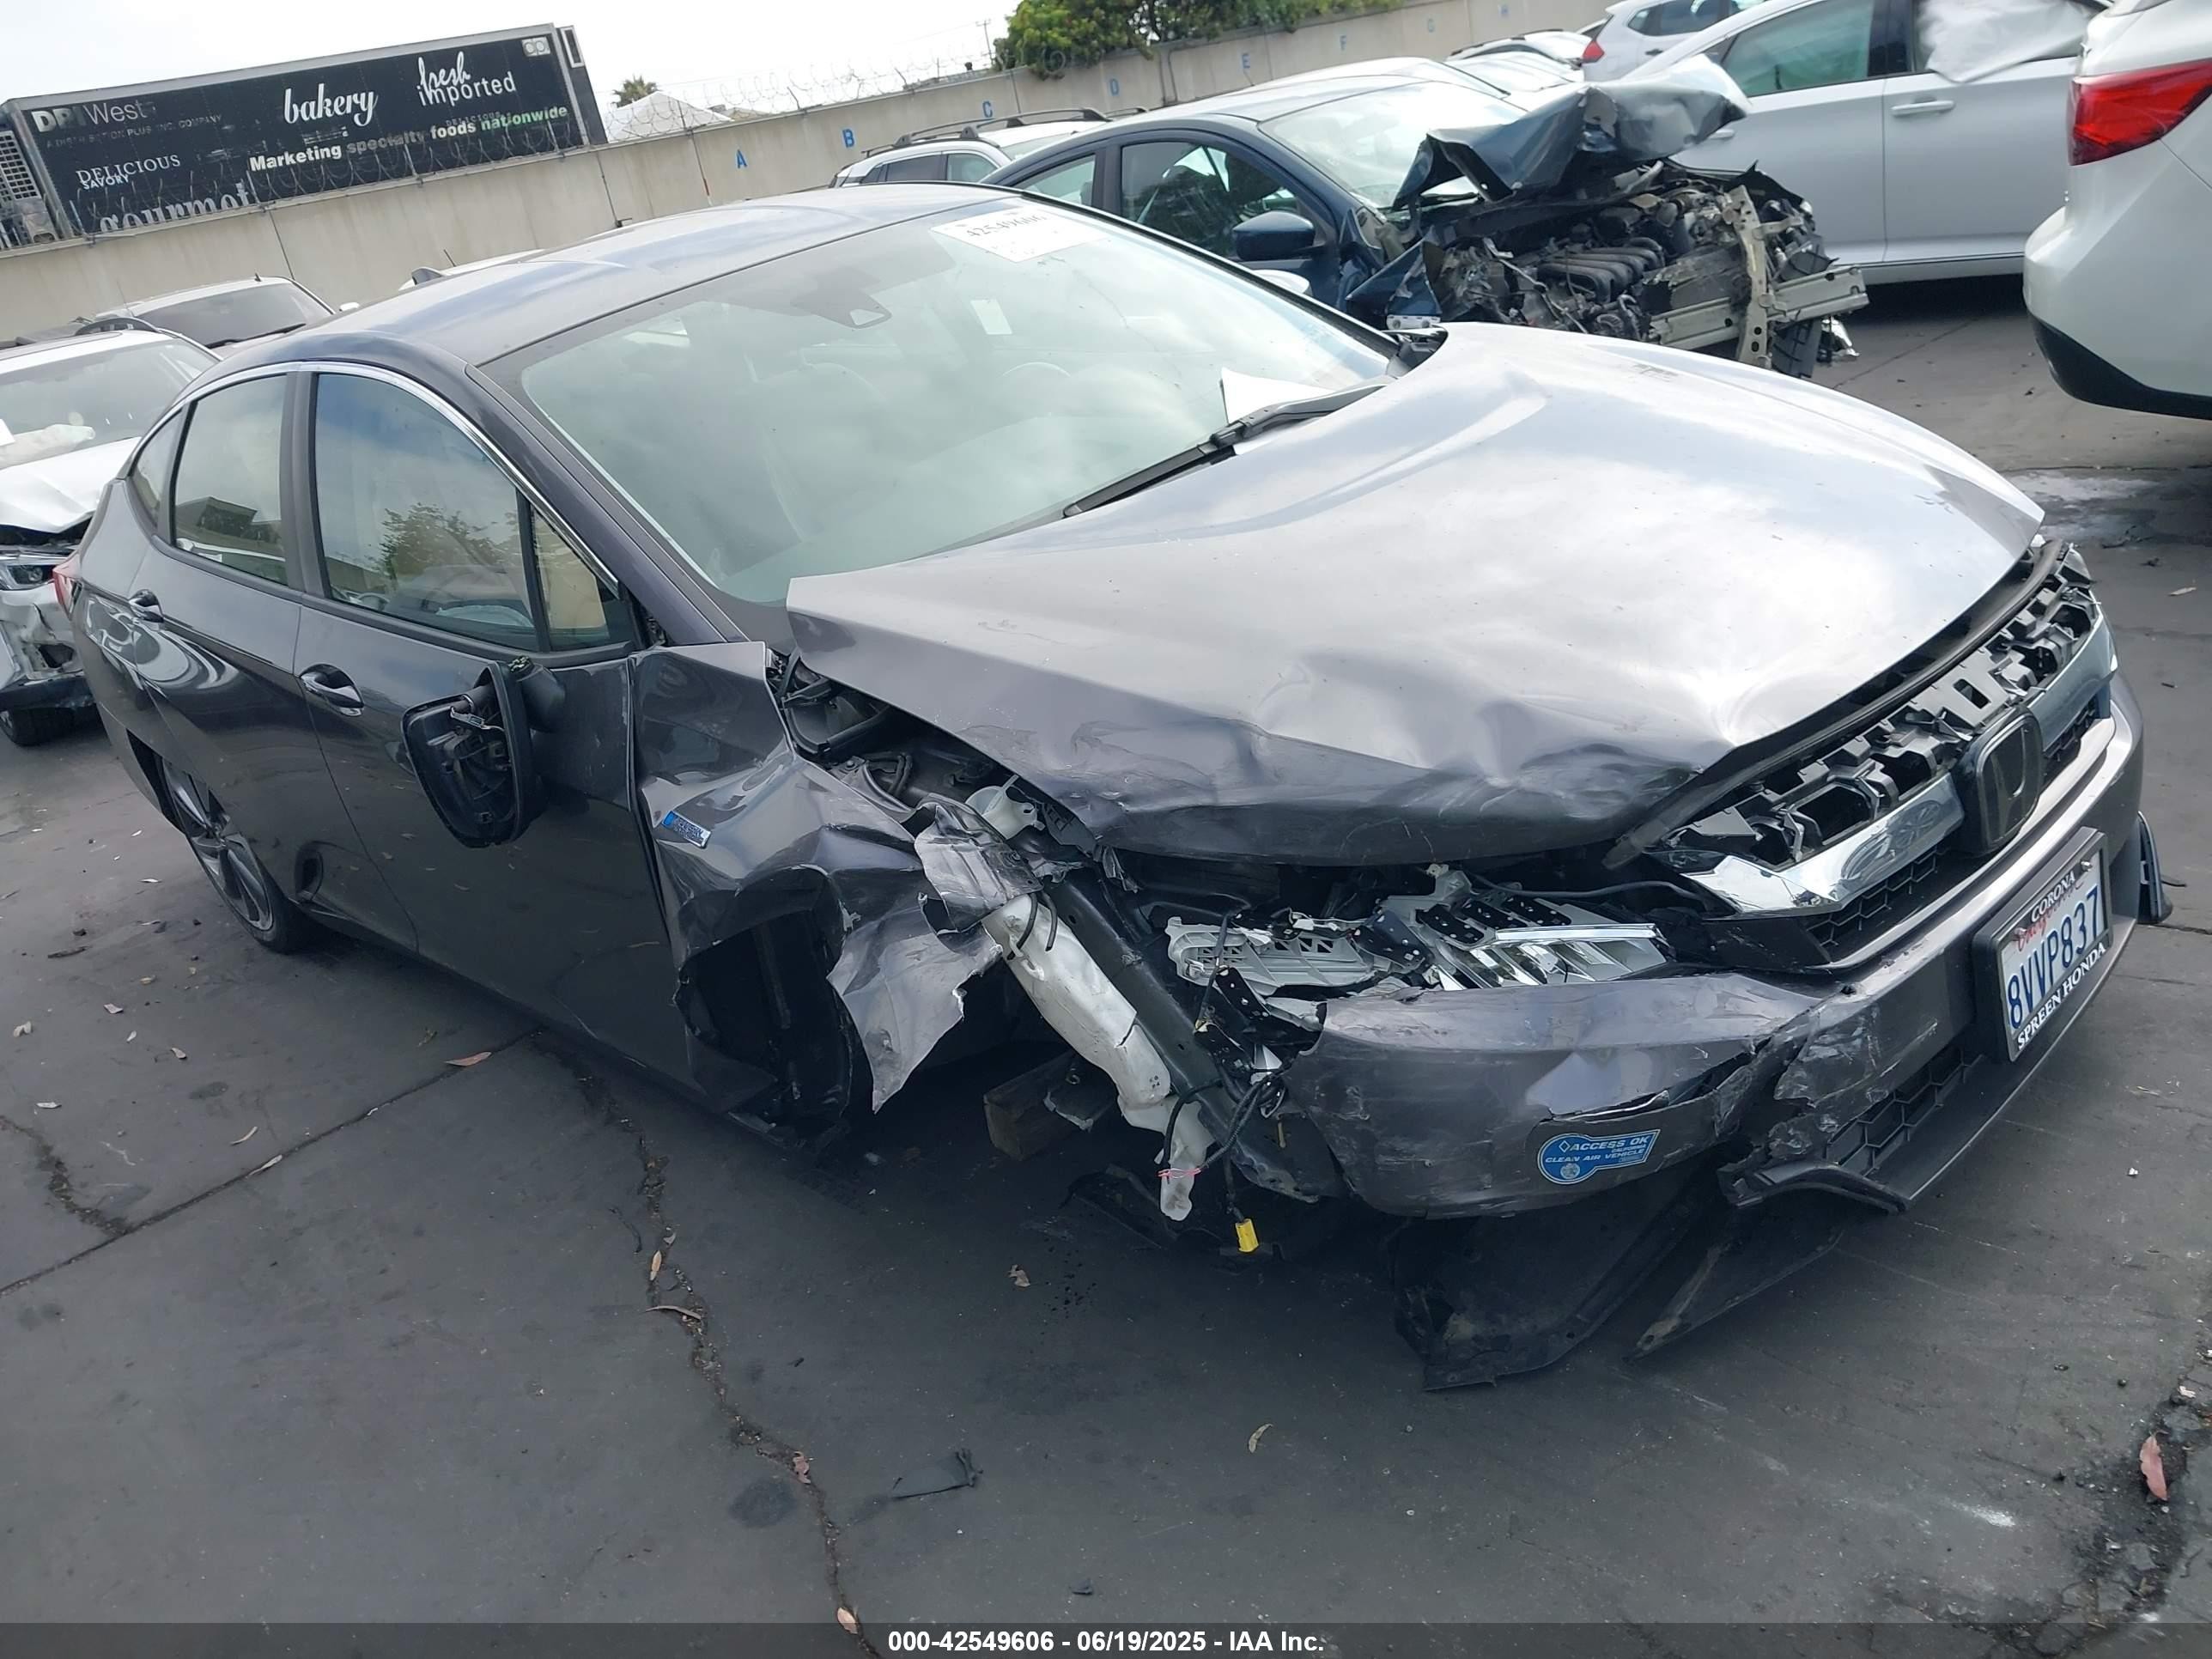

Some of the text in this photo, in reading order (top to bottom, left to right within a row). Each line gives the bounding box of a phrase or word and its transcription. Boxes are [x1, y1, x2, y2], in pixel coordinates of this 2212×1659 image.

[1242, 53, 1250, 69] E
[416, 71, 516, 106] imported
[418, 51, 471, 104] fresh
[1109, 78, 1120, 96] D
[83, 100, 148, 125] West
[284, 83, 378, 126] bakery
[982, 100, 994, 118] C
[249, 144, 342, 172] Marketing
[347, 131, 425, 155] specialty
[430, 121, 477, 140] foods
[480, 106, 568, 131] nationwide
[842, 129, 855, 149] B
[76, 155, 181, 182] DELICIOUS
[735, 149, 748, 169] A
[82, 174, 130, 190] SAVORY
[2031, 870, 2075, 923] CORONA
[2008, 884, 2099, 1030] 8VVP837
[2017, 988, 2062, 1050] SPREEN
[2061, 942, 2106, 998] HONDA
[1570, 1135, 1650, 1152] ACCESS OK
[1604, 1149, 1644, 1159] VEHICLE
